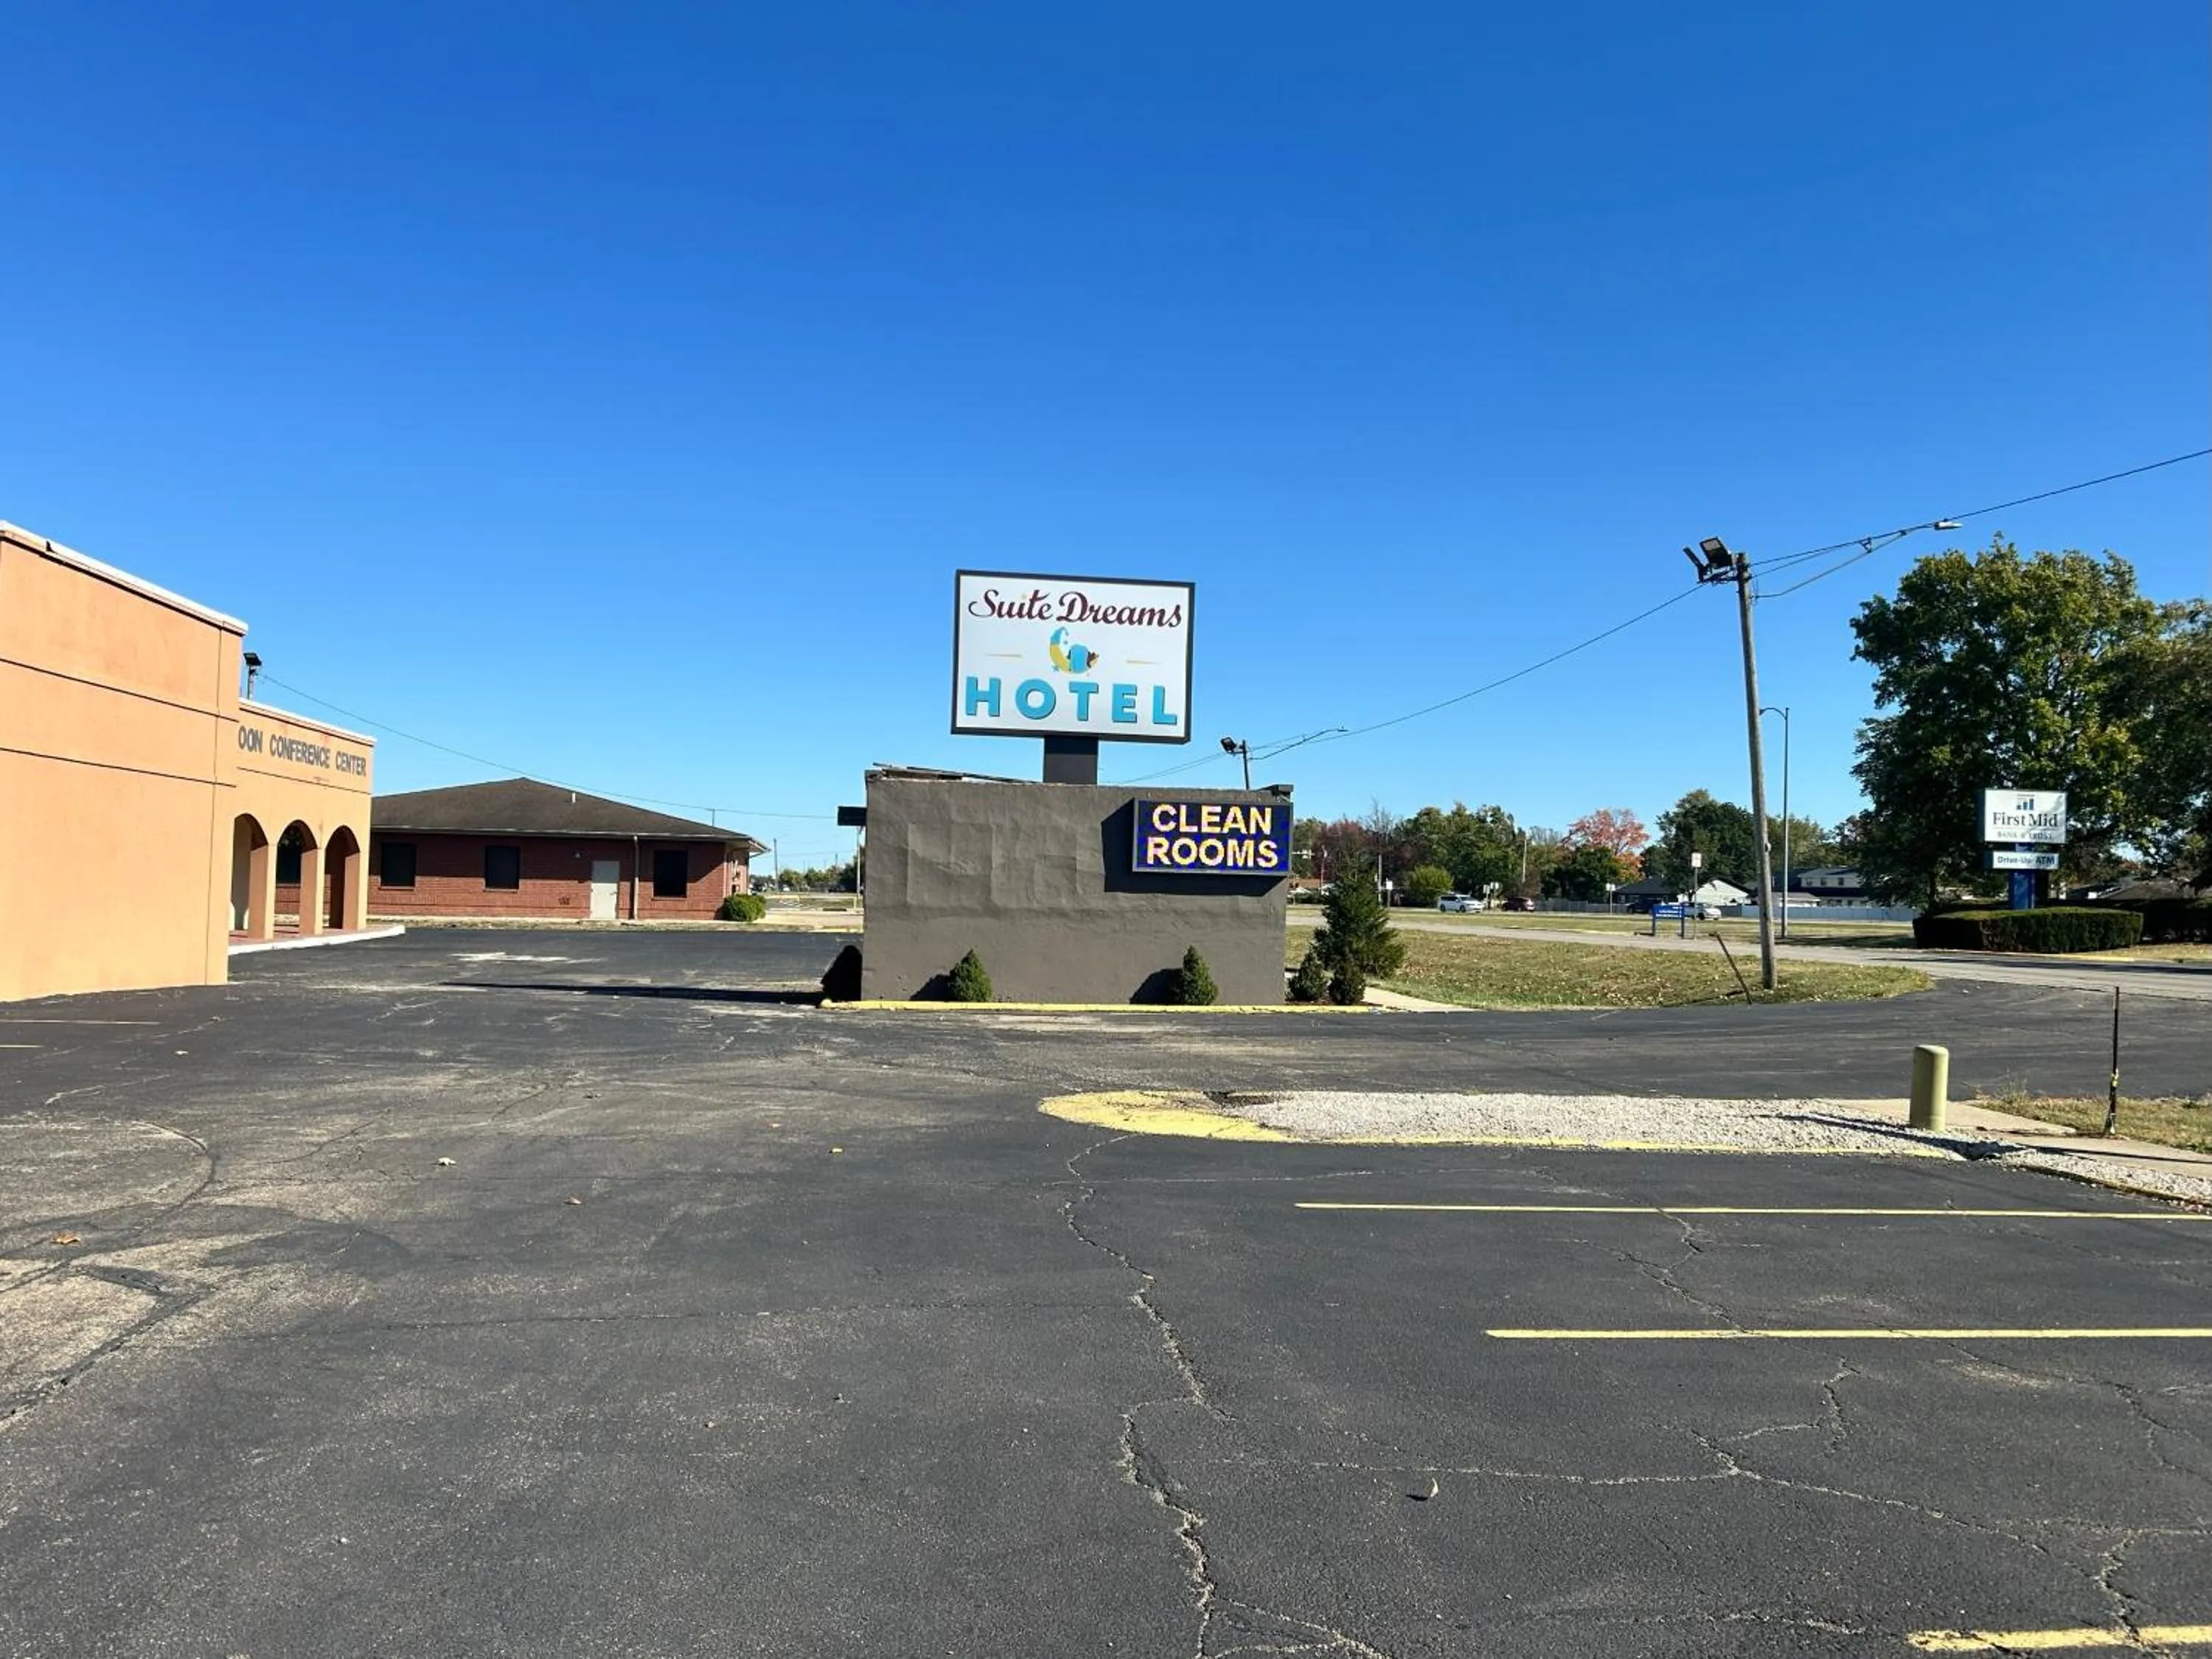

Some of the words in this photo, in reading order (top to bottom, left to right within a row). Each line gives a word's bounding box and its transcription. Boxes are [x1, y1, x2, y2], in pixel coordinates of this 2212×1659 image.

[968, 589, 1053, 620] Suite
[1057, 591, 1181, 627] Dreams
[965, 676, 1178, 725] HOTEL
[238, 726, 263, 754] OON
[270, 734, 331, 768] CONFERENCE
[335, 751, 366, 777] CENTER
[1152, 804, 1272, 835] CLEAN
[1993, 812, 2026, 826] First
[2028, 813, 2058, 827] Mid
[1147, 837, 1279, 868] ROOMS
[2036, 855, 2055, 865] ATM
